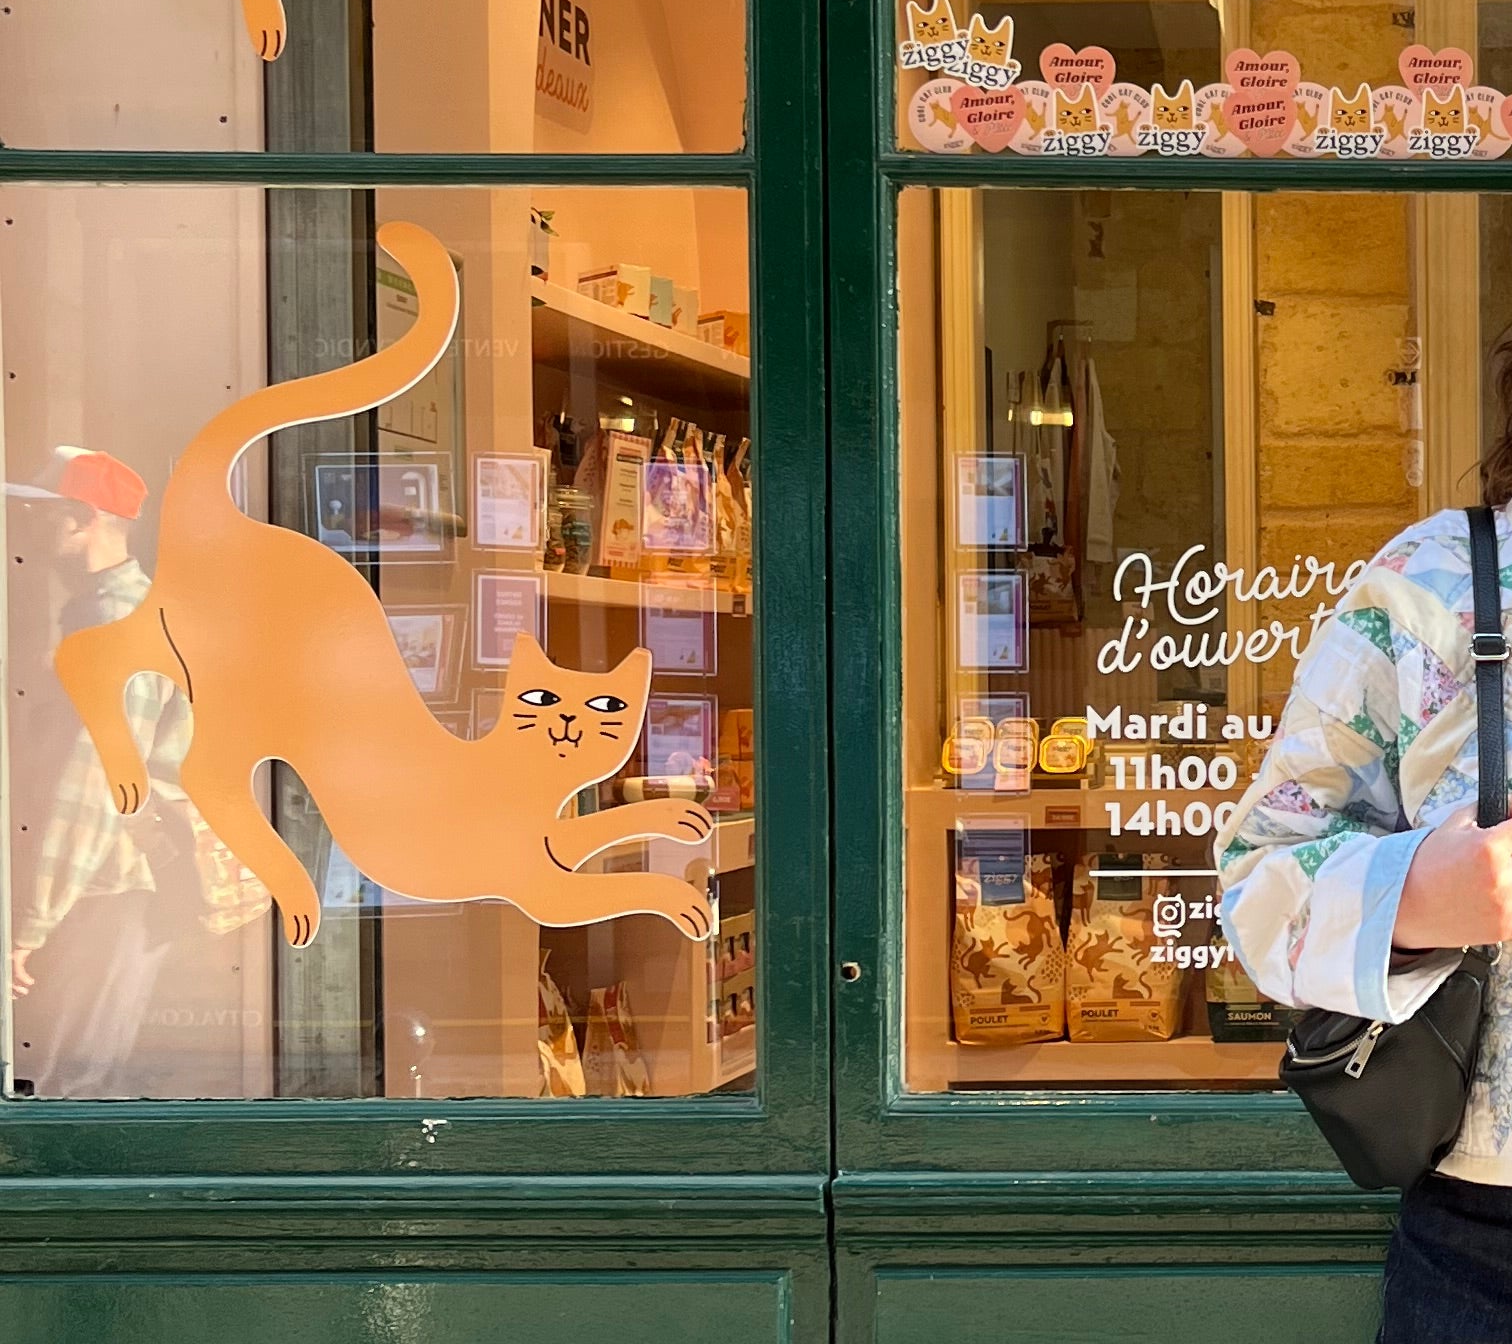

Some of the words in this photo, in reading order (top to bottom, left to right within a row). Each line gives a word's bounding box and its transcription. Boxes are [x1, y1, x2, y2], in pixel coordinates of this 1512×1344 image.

[903, 39, 970, 68] ziggy
[1049, 55, 1105, 70] Amour,
[1234, 60, 1290, 74] Amour,
[1408, 57, 1463, 71] Amour,
[948, 59, 1017, 87] ziggy
[1054, 72, 1103, 84] Gloire
[1413, 72, 1461, 85] Gloire
[1240, 76, 1289, 88] Gloire
[959, 93, 1016, 109] Amour,
[1231, 99, 1287, 115] Amour,
[966, 109, 1015, 124] Gloire
[1239, 115, 1286, 130] Gloire
[1043, 131, 1111, 156] ziggy
[1137, 127, 1206, 152] ziggy
[1316, 129, 1384, 156] ziggy
[1409, 129, 1478, 156] ziggy
[1086, 703, 1208, 740] Mardi
[1221, 714, 1272, 740] au
[1109, 754, 1238, 791] 11h00
[1104, 799, 1238, 836] 14h00
[970, 1014, 1009, 1024] POULET
[1081, 1009, 1120, 1018] POULET
[1227, 1012, 1272, 1021] SAUMON
